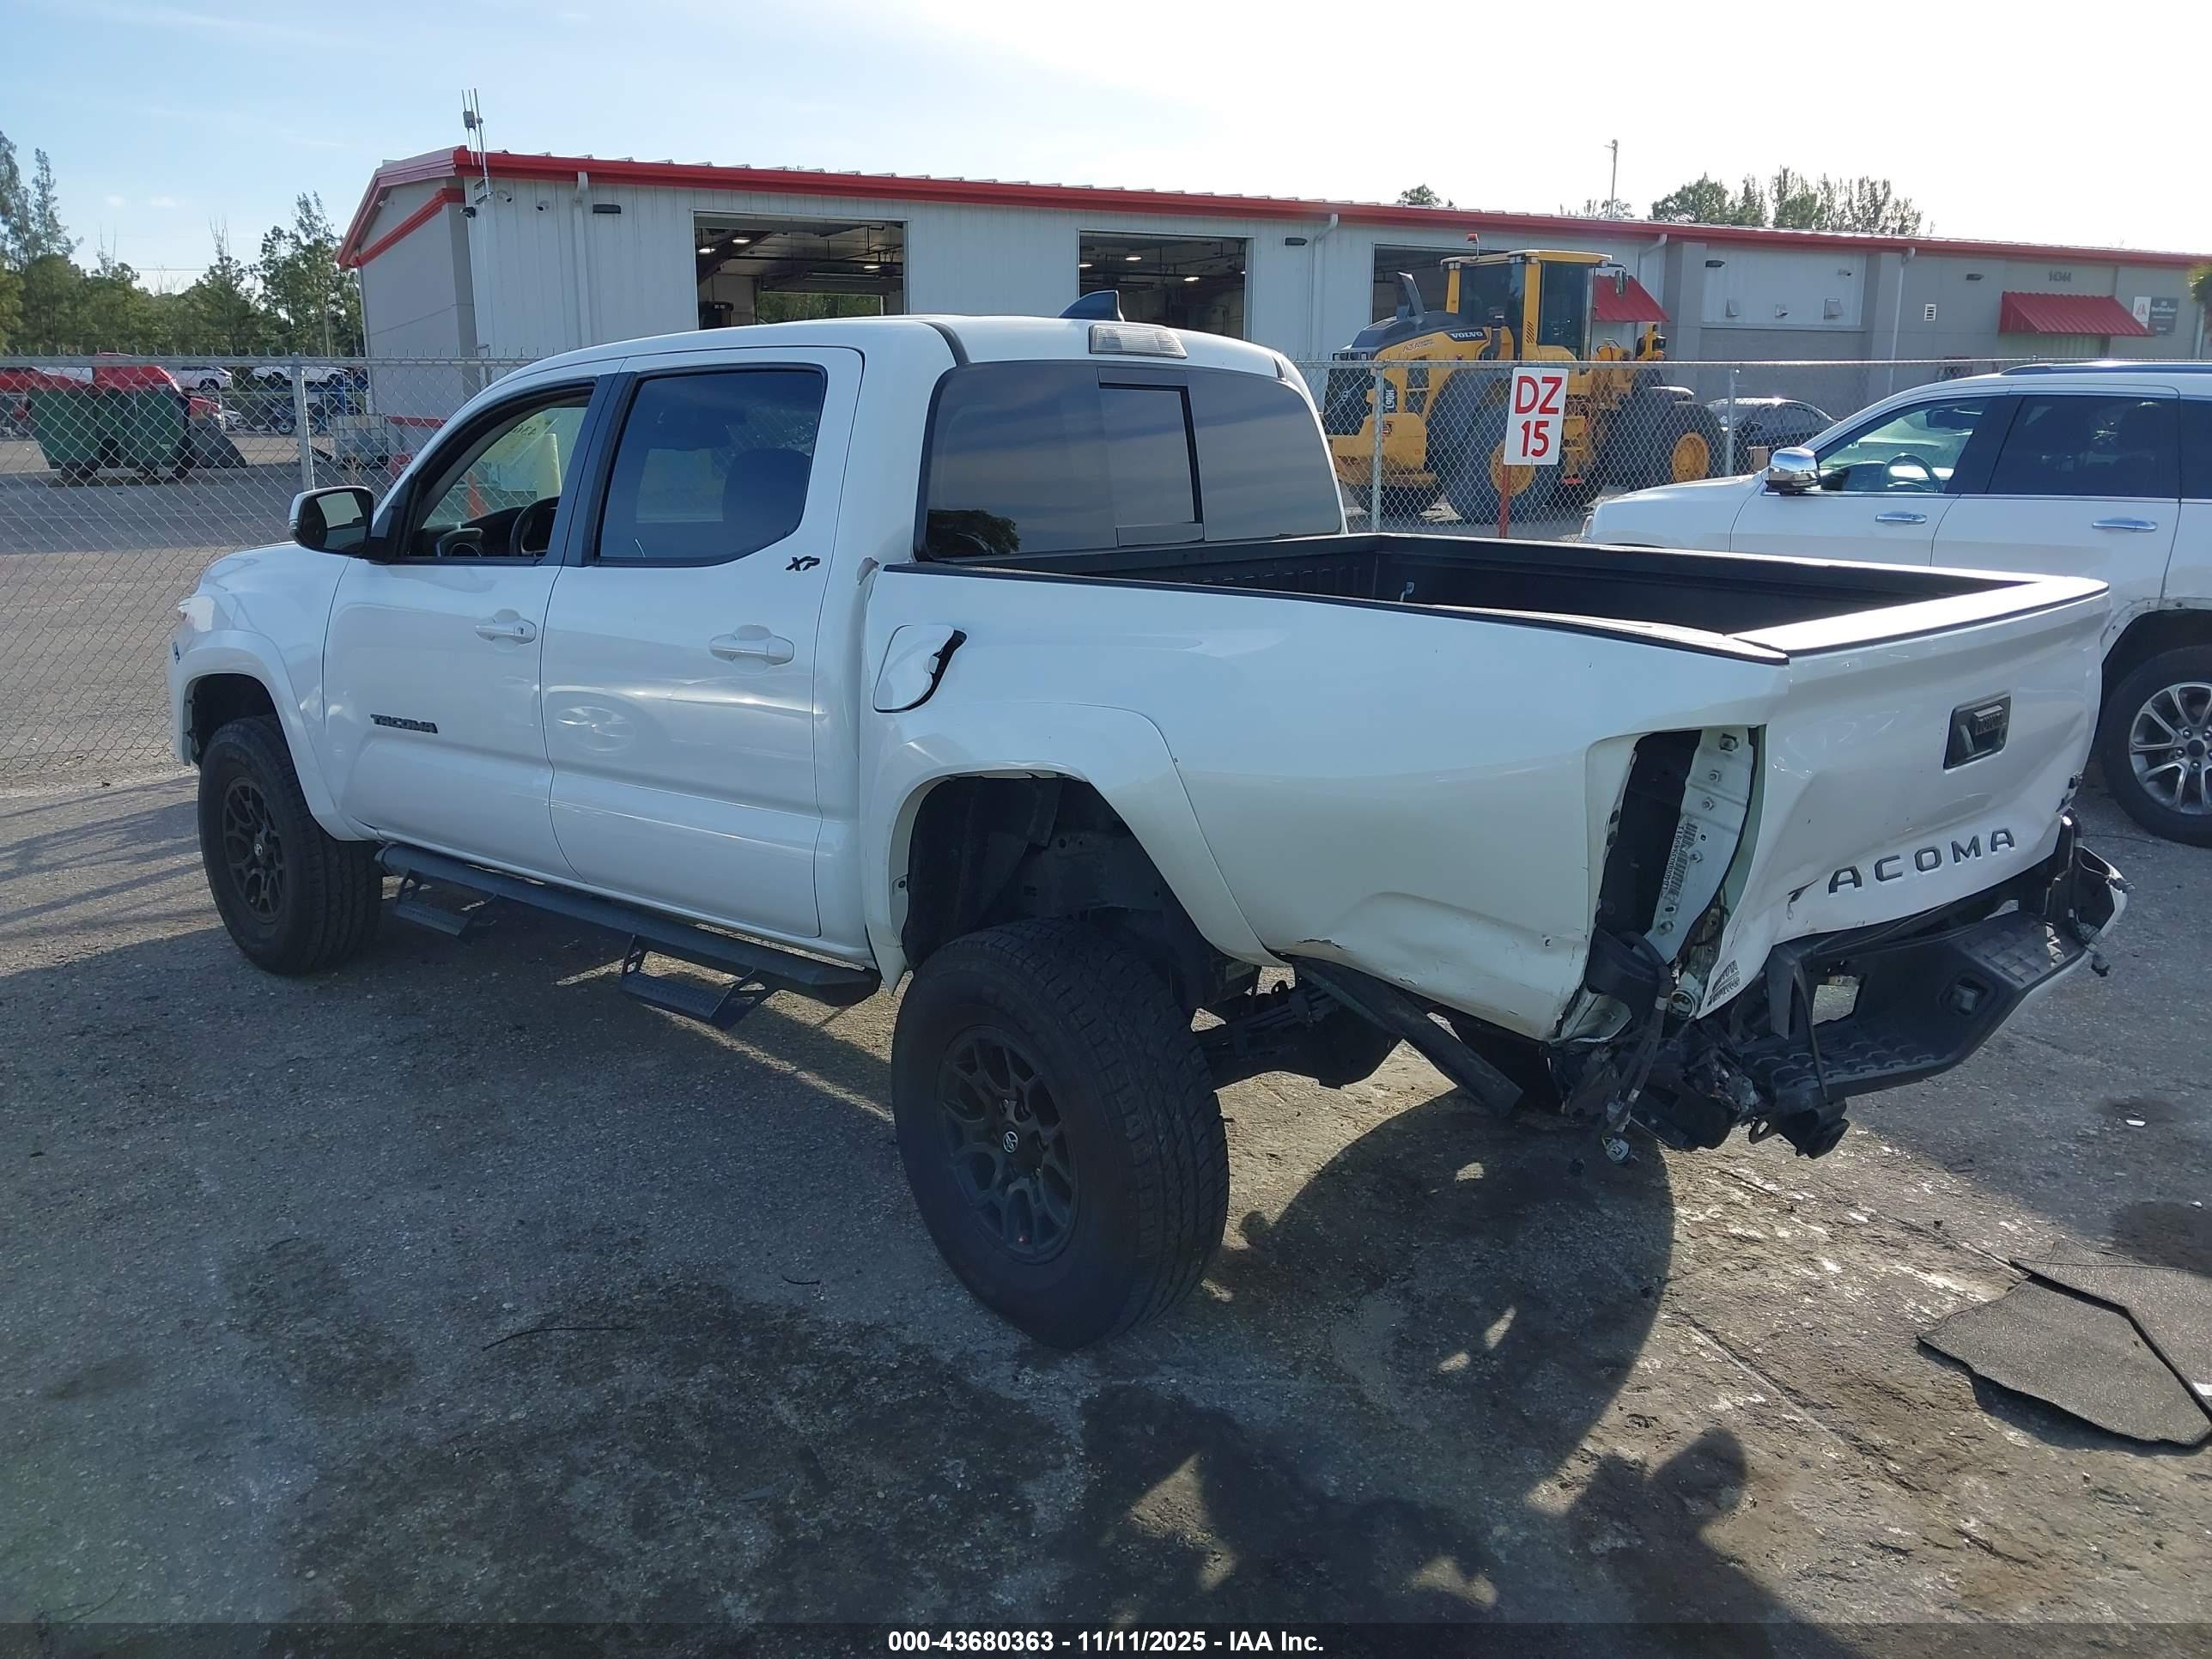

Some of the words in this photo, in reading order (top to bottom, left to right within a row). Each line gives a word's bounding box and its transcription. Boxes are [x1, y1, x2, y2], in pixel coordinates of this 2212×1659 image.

[1515, 376, 1563, 414] DZ
[1521, 420, 1549, 457] 15
[369, 714, 439, 734] TACOMA
